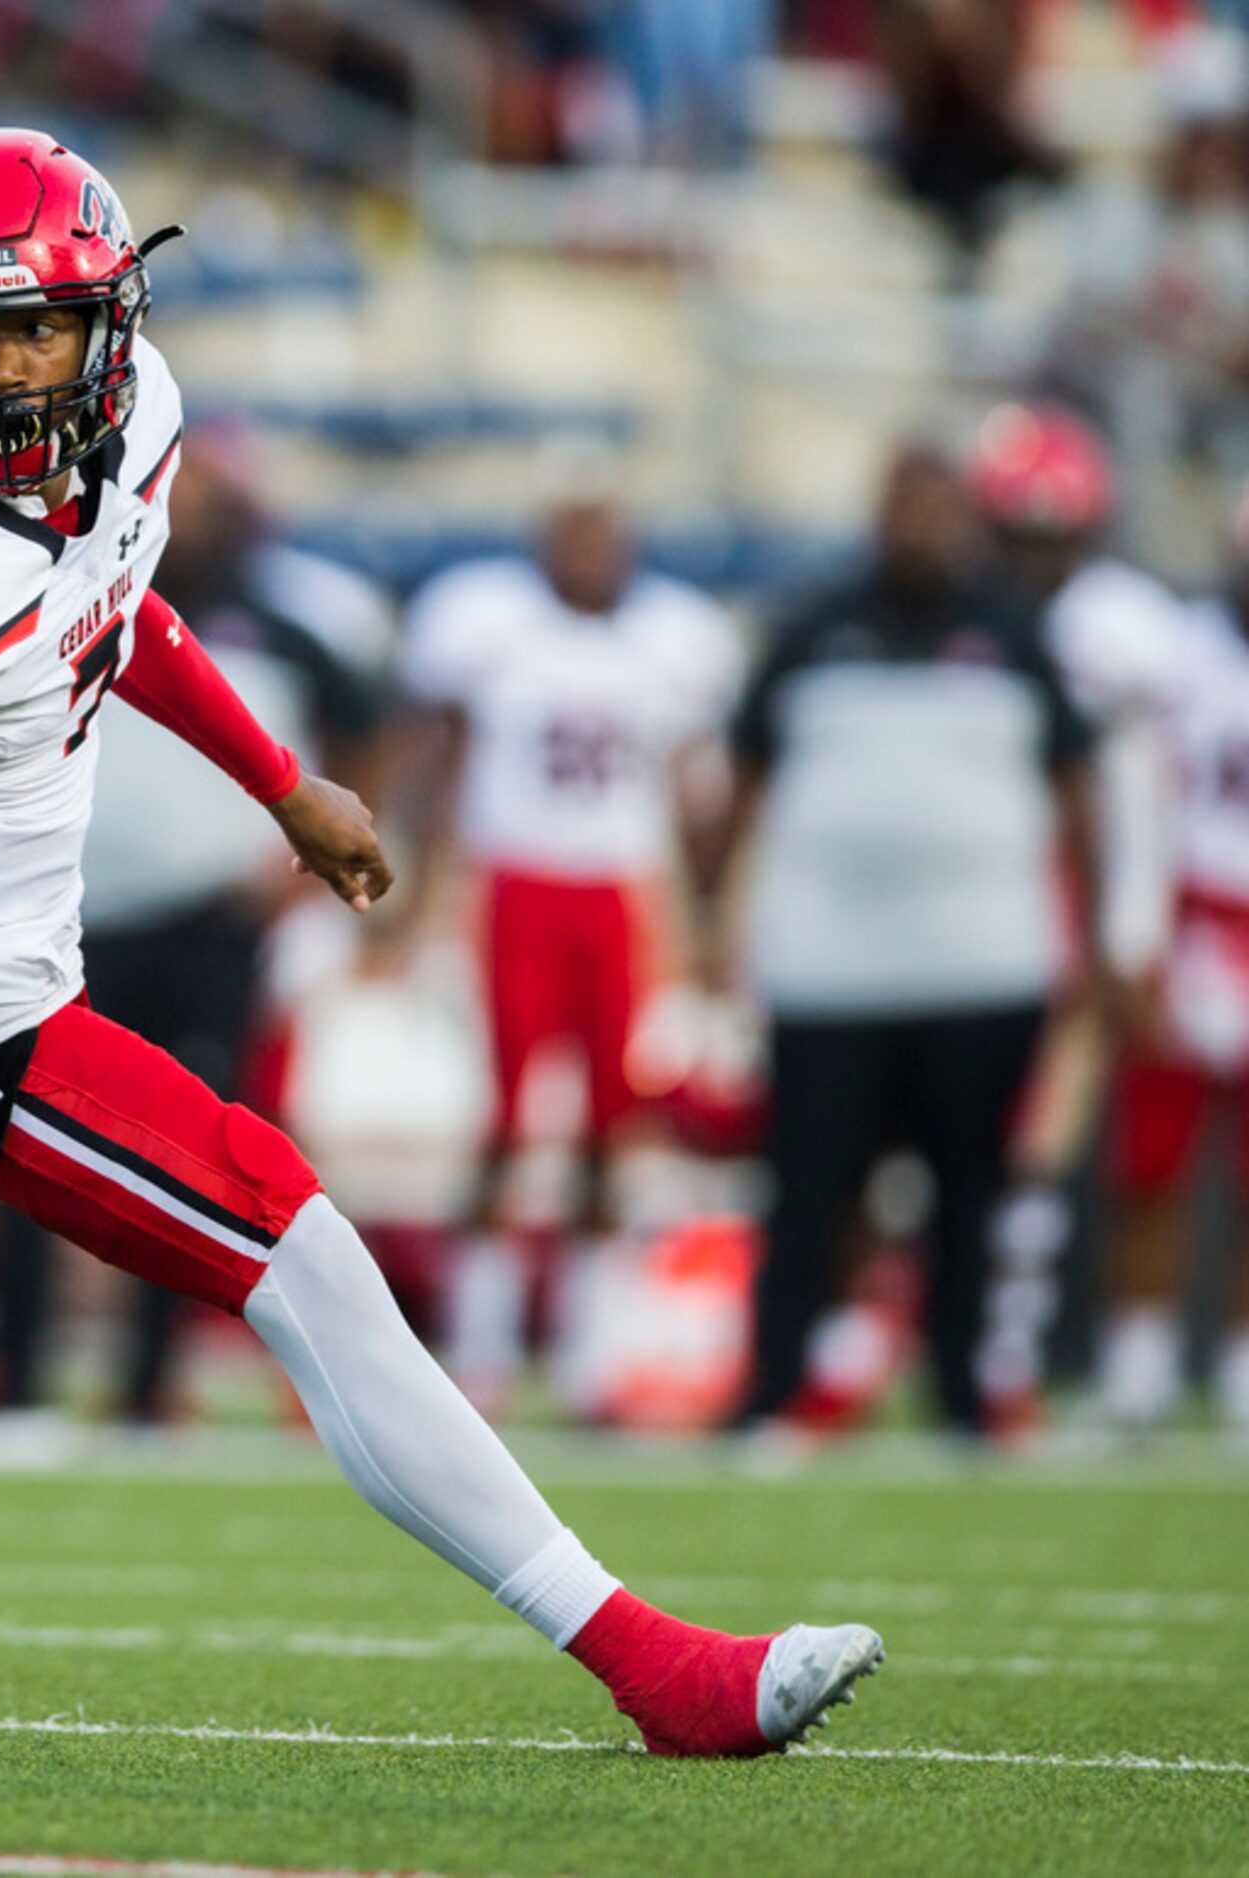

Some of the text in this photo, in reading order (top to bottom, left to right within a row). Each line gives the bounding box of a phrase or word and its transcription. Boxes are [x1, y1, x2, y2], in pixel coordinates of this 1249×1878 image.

[59, 565, 133, 661] CEDAR HILL
[64, 610, 125, 759] 7
